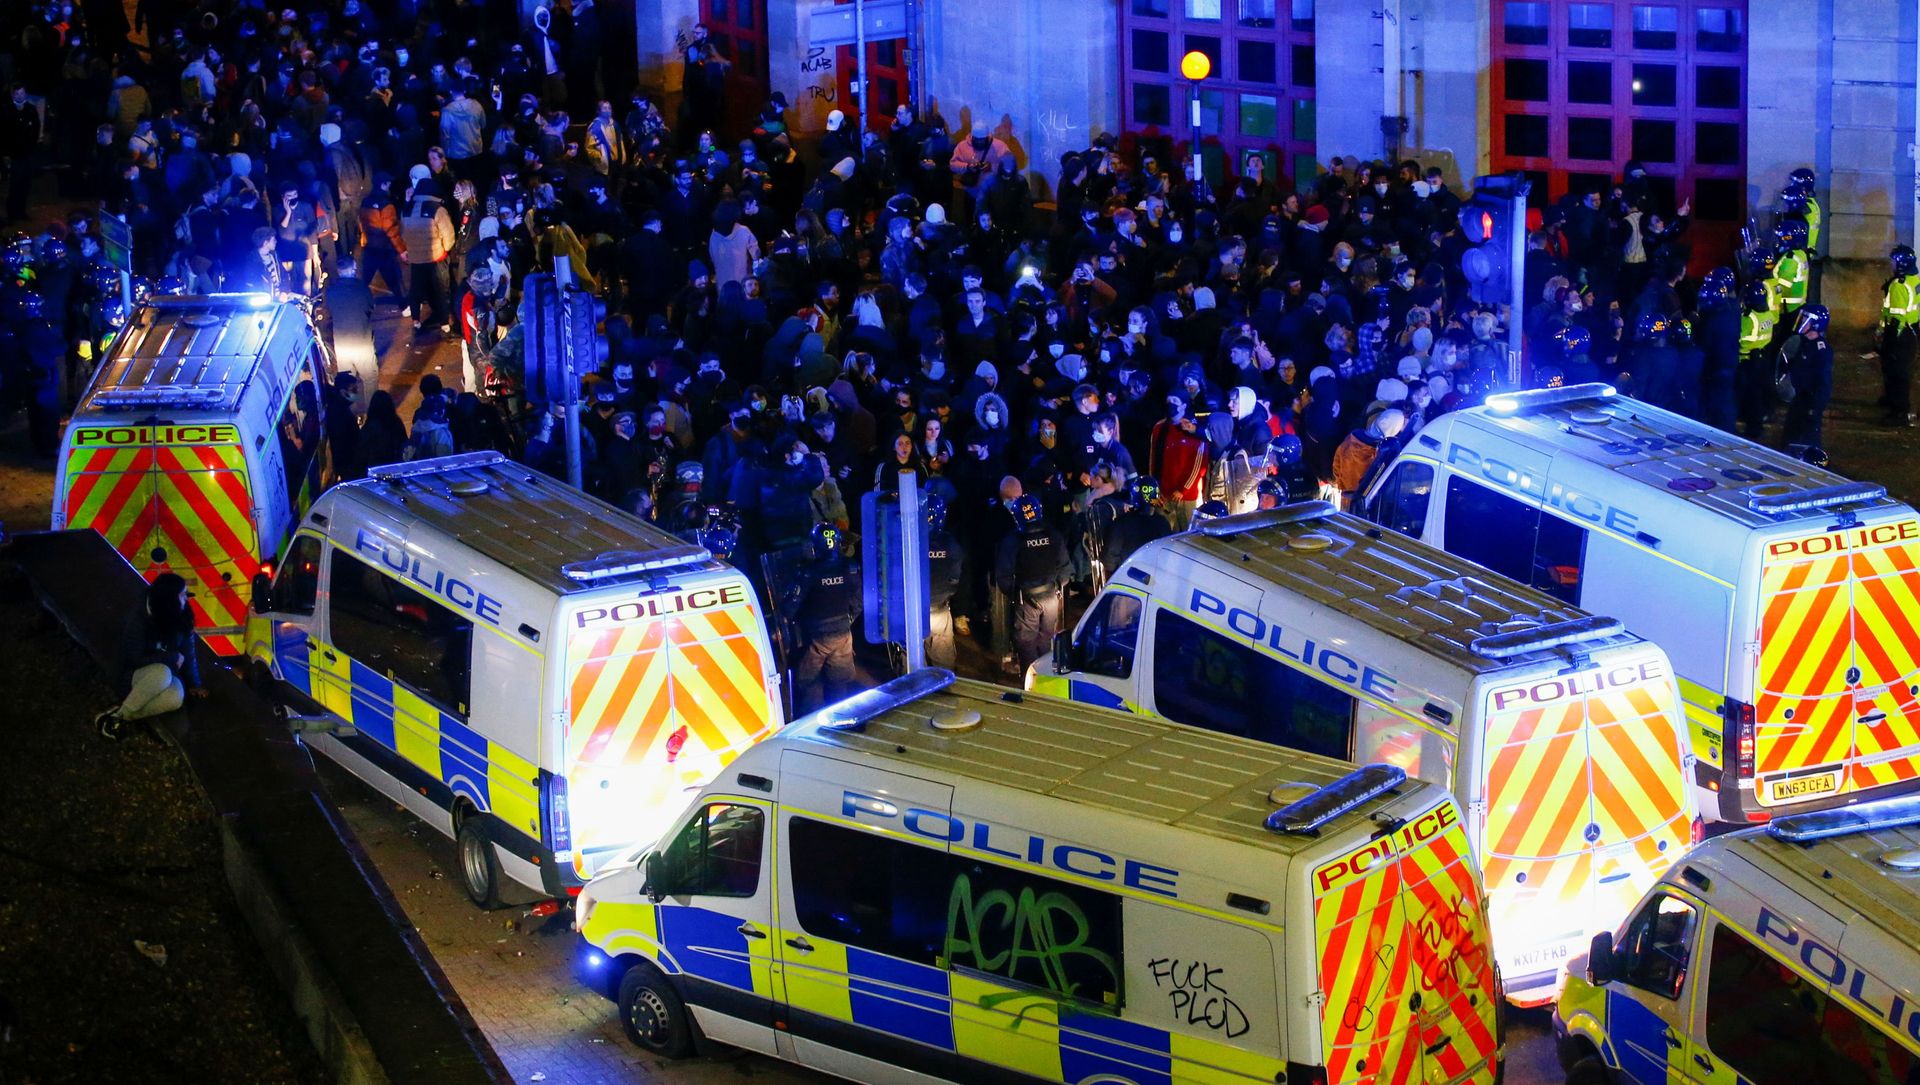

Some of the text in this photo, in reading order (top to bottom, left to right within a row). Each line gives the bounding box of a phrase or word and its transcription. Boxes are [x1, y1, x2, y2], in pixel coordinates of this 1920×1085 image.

[801, 57, 832, 72] ACAB
[1037, 109, 1077, 133] KILL
[266, 339, 302, 429] POLICE
[77, 427, 233, 444] POLICE
[1448, 443, 1640, 533] POLICE
[1027, 538, 1050, 547] POLICE
[1770, 521, 1919, 555] POLICE
[356, 528, 503, 625] POLICE
[822, 577, 844, 585] POLICE
[576, 585, 744, 628] POLICE
[1190, 587, 1398, 703] POLICE
[1494, 660, 1663, 710] POLICE
[1778, 778, 1830, 796] WN63 CFA
[842, 790, 1179, 897] POLICE
[1318, 802, 1457, 892] POLICE
[943, 874, 1119, 1008] ACAB
[1148, 958, 1227, 994] FUCK
[1756, 907, 1920, 1042] POLI
